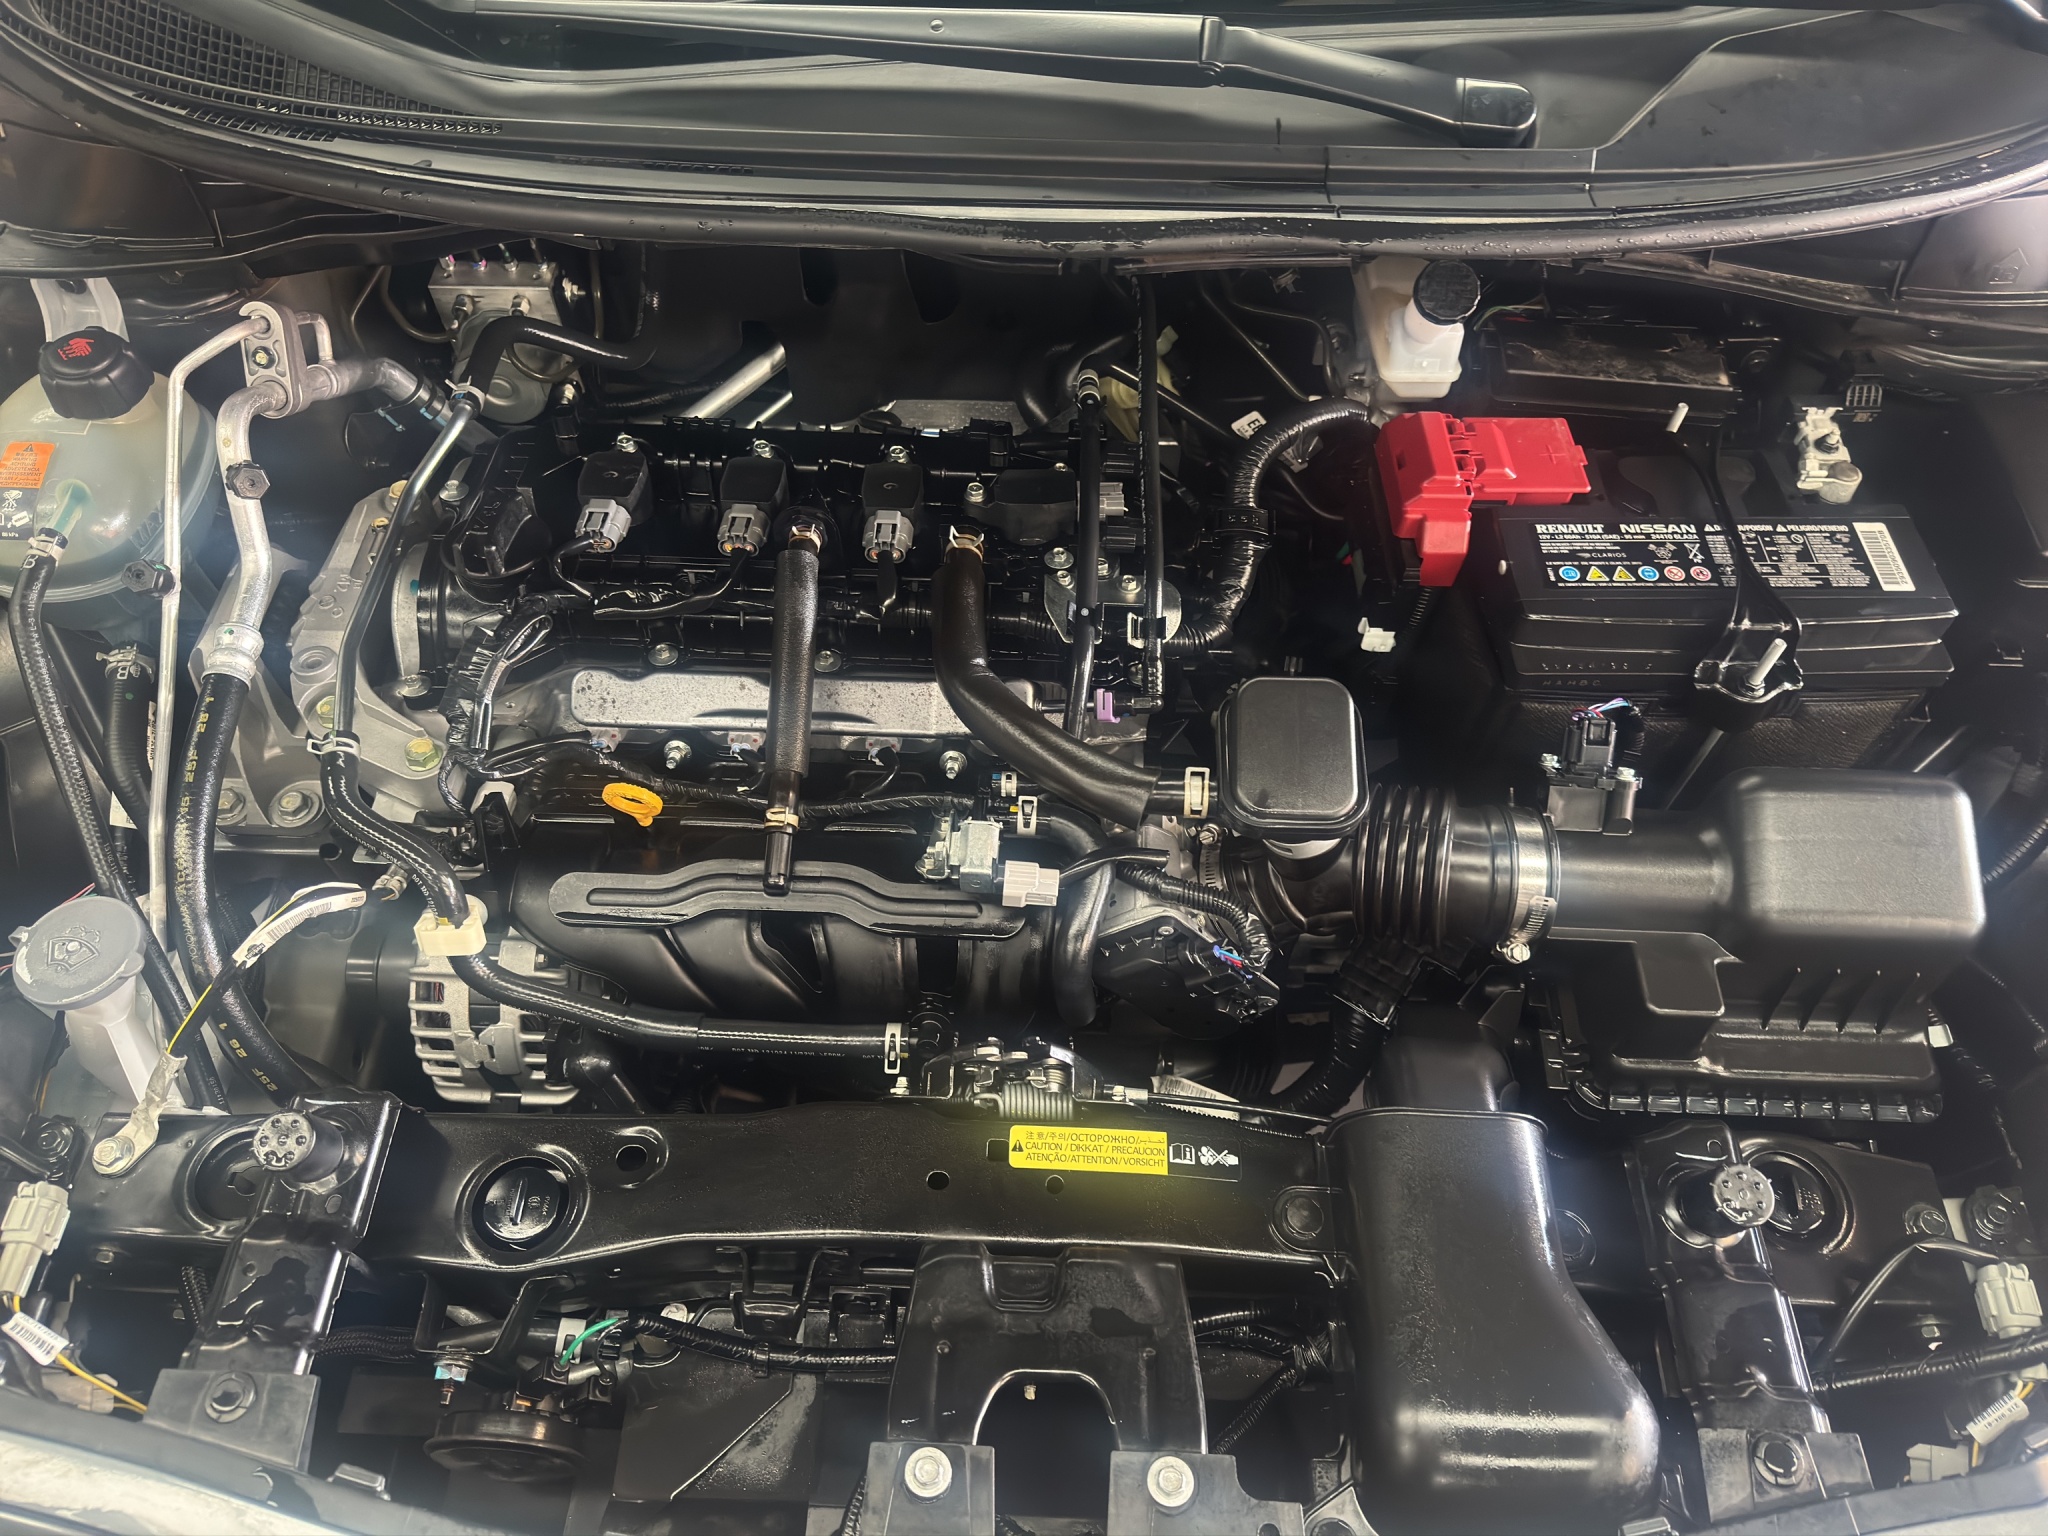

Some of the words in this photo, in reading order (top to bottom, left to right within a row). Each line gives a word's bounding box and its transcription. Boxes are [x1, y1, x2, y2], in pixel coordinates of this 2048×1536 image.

[1534, 524, 1604, 534] RENAULT
[1619, 524, 1697, 534] NISSAN
[1786, 524, 1849, 532] PELIGRO/VENENO
[228, 1038, 248, 1058] 26
[251, 1067, 278, 1092] 25F
[1025, 1141, 1063, 1151] CAUTION
